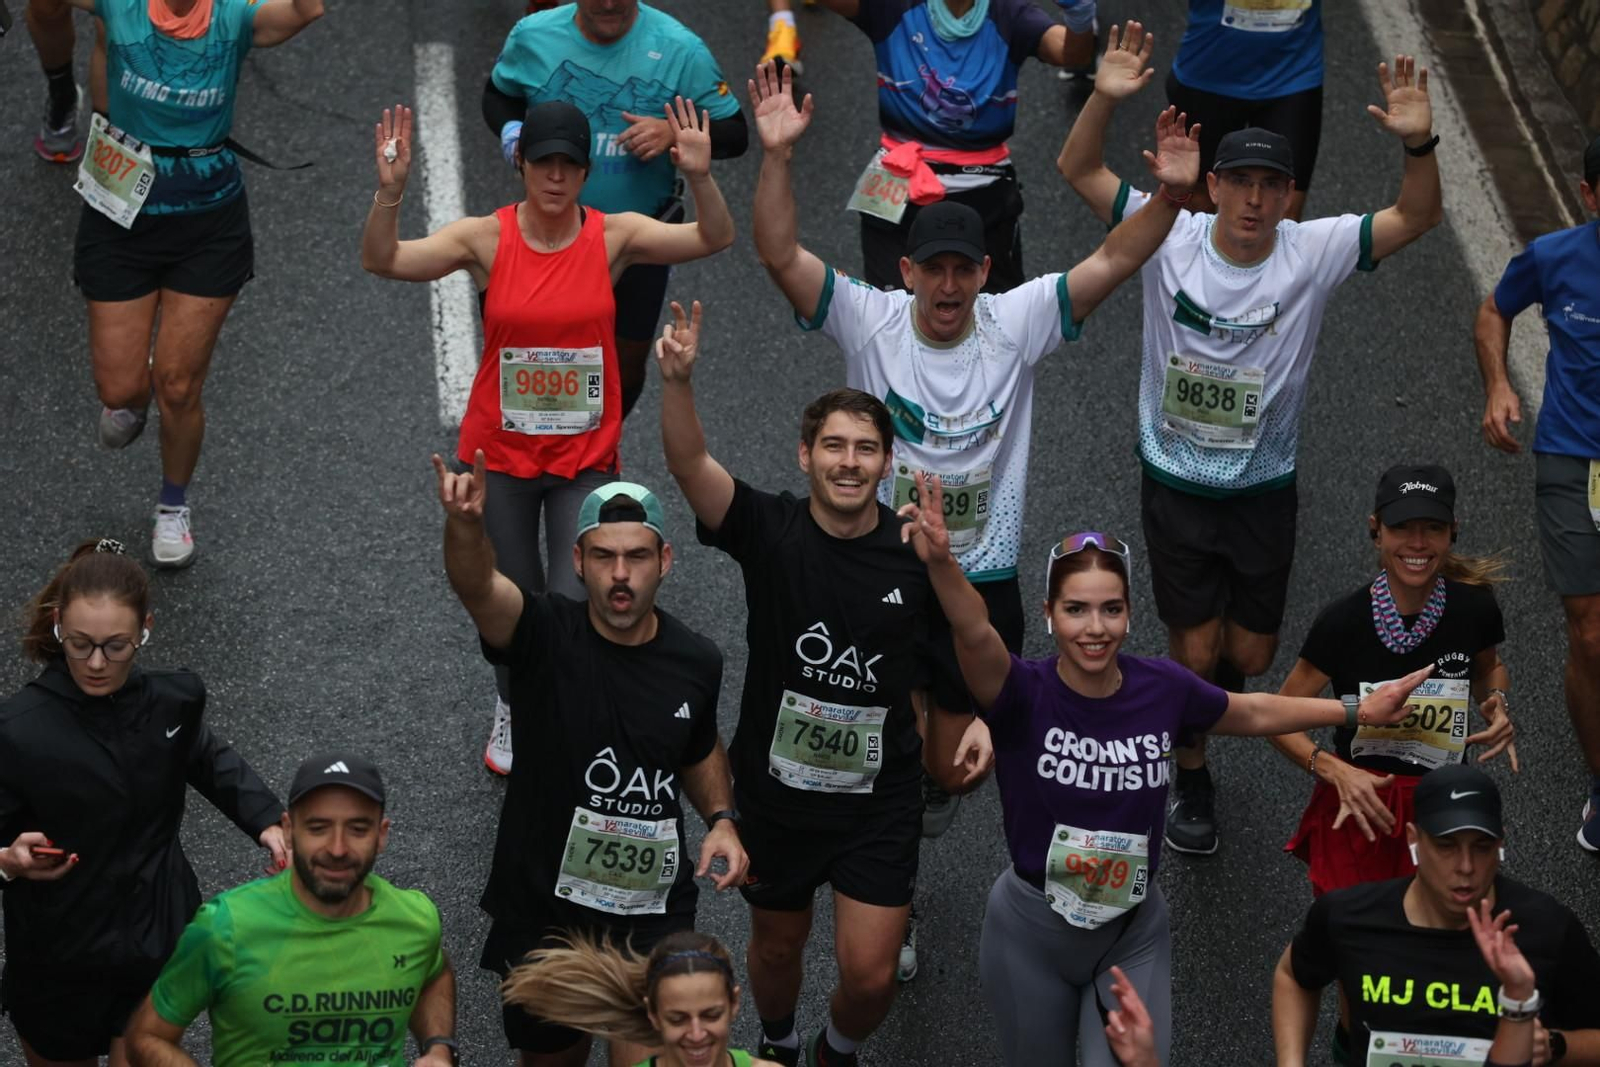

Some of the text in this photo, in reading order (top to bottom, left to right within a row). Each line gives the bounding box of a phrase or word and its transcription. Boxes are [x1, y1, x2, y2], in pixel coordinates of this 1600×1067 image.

[120, 70, 171, 102] RITMO
[515, 369, 579, 396] 9896
[1176, 377, 1236, 412] 9838
[908, 486, 970, 516] 939
[1437, 652, 1470, 666] RUGBY
[802, 665, 876, 693] STUDIO
[793, 718, 859, 757] 7540
[1044, 727, 1171, 764] CROHN'S &
[584, 746, 675, 800] ÔAK
[1036, 753, 1143, 792] COLITIS
[589, 794, 663, 815] STUDIO
[584, 837, 656, 875] 7539
[1362, 974, 1502, 1015] MJ CLA
[288, 1016, 395, 1045] sano
[329, 1049, 350, 1062] del
